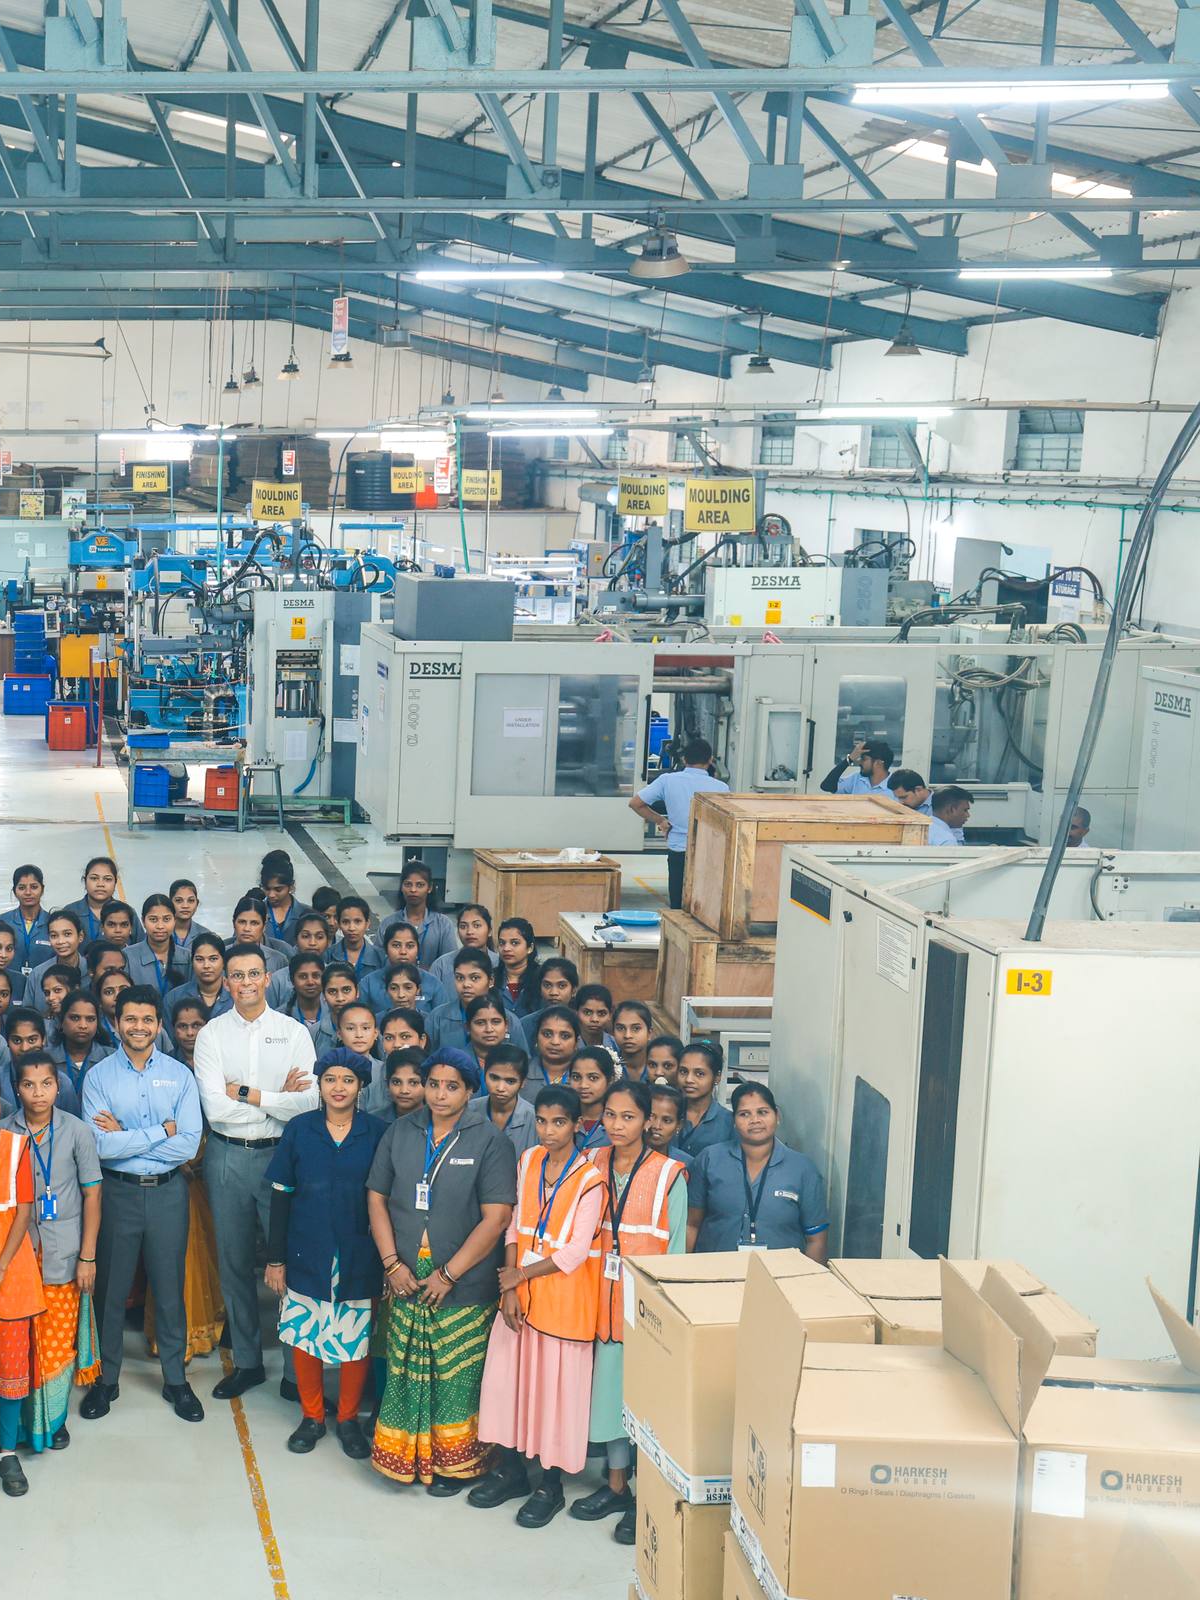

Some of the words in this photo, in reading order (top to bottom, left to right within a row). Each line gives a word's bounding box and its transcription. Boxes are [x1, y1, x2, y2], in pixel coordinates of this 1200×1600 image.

[136, 470, 165, 478] FINISHING
[398, 481, 414, 489] AREA
[621, 482, 666, 496] MOULDING
[256, 488, 298, 501] MOULDING
[689, 488, 750, 504] MOULDING
[261, 505, 285, 516] AREA
[627, 500, 651, 511] AREA
[698, 510, 730, 524] AREA
[752, 576, 801, 587] DESMA
[283, 599, 315, 607] DESMA
[1154, 691, 1191, 713] DESMA
[1017, 972, 1043, 992] I-3
[894, 1466, 947, 1479] HARKESH
[1126, 1473, 1182, 1486] HARKESH
[848, 1487, 868, 1497] Rings
[874, 1489, 894, 1497] Seals
[900, 1489, 941, 1500] Diaphragms
